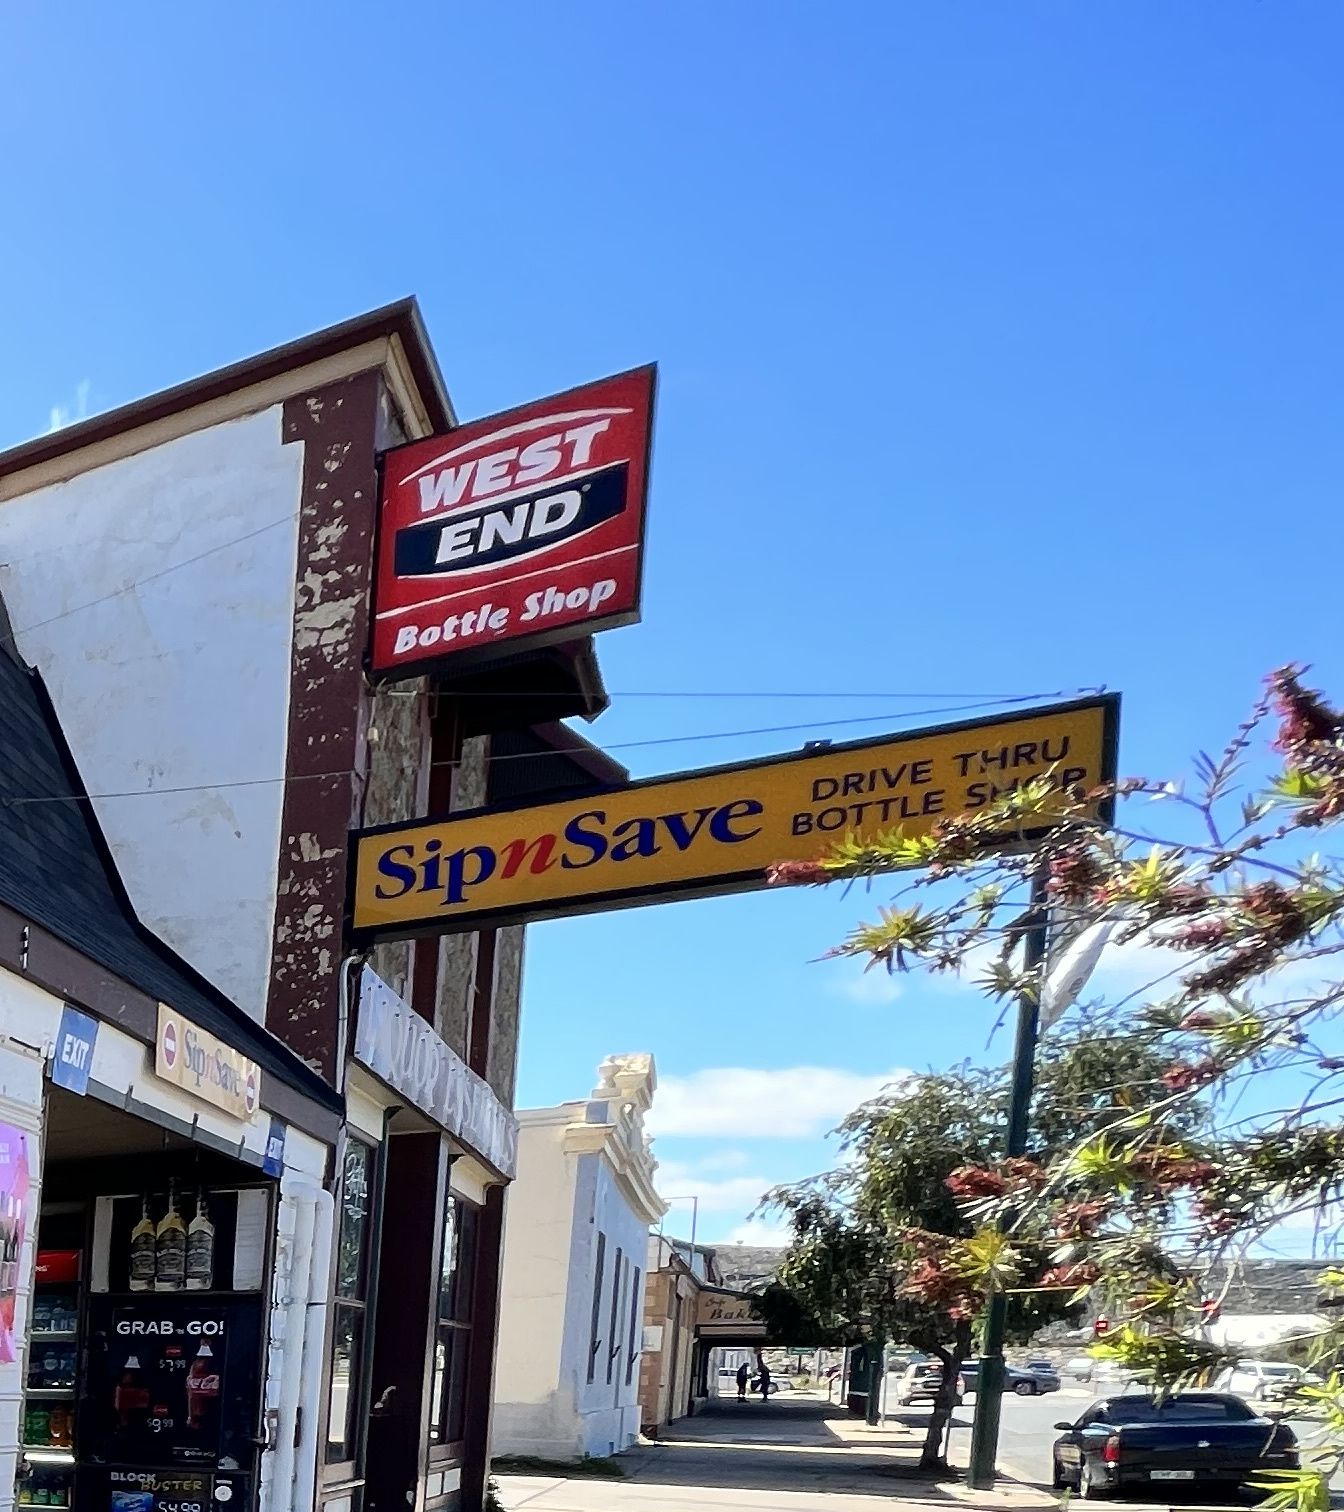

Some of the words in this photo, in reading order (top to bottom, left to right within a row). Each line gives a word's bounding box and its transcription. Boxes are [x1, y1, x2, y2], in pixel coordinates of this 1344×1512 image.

[418, 418, 612, 513] WEST
[434, 488, 584, 566] END
[393, 603, 510, 655] Bottle
[522, 579, 618, 622] Shop
[812, 759, 934, 803] DRIVE
[952, 735, 1071, 777] THRU
[791, 789, 945, 837] BOTTLE
[374, 797, 764, 906] SipnSave
[62, 1033, 89, 1071] EXIT
[116, 1321, 174, 1335] GRAB
[186, 1320, 224, 1335] GO!
[110, 1472, 156, 1482] BLOCK
[141, 1480, 202, 1491] BUSTER
